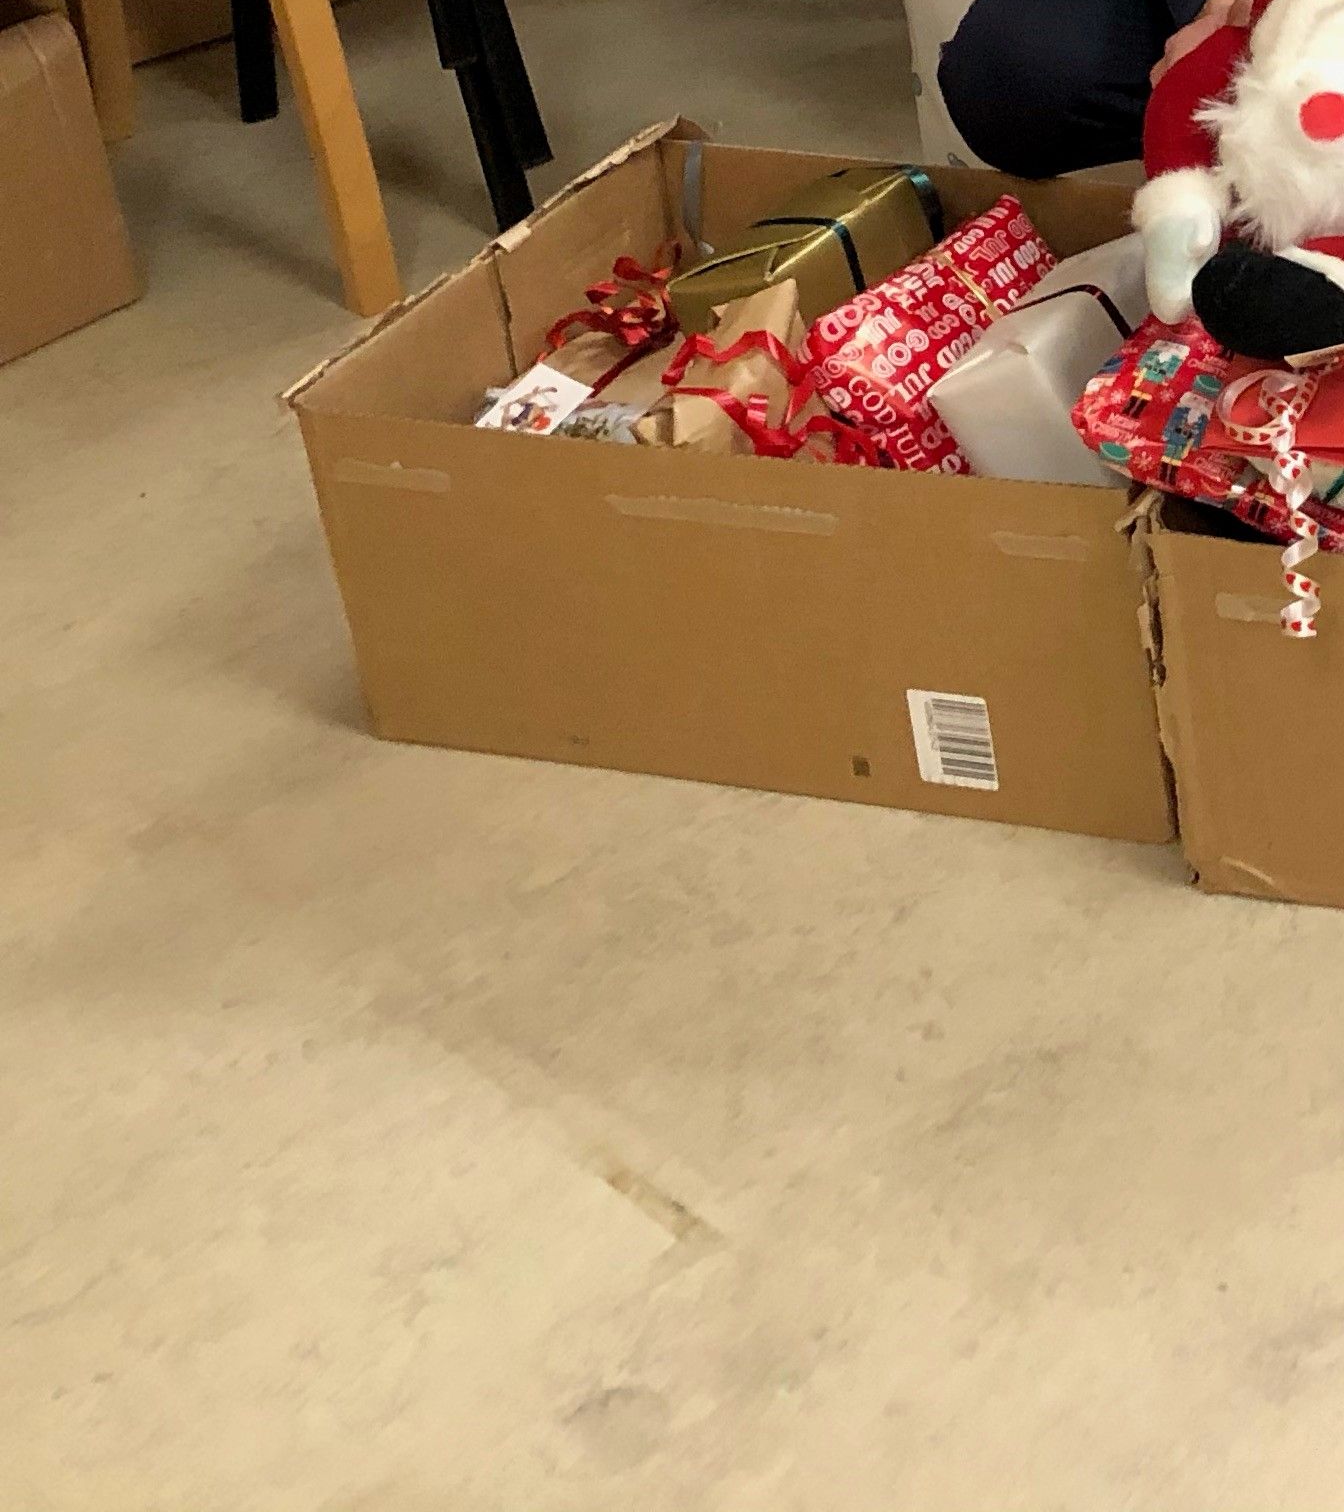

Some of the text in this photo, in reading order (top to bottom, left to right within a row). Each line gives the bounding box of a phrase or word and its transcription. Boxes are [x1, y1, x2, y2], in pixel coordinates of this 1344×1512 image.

[820, 293, 882, 342] GOD
[872, 329, 929, 378] GOD
[890, 363, 934, 403] JUL
[848, 376, 897, 424] GOD
[885, 423, 926, 470] JUL
